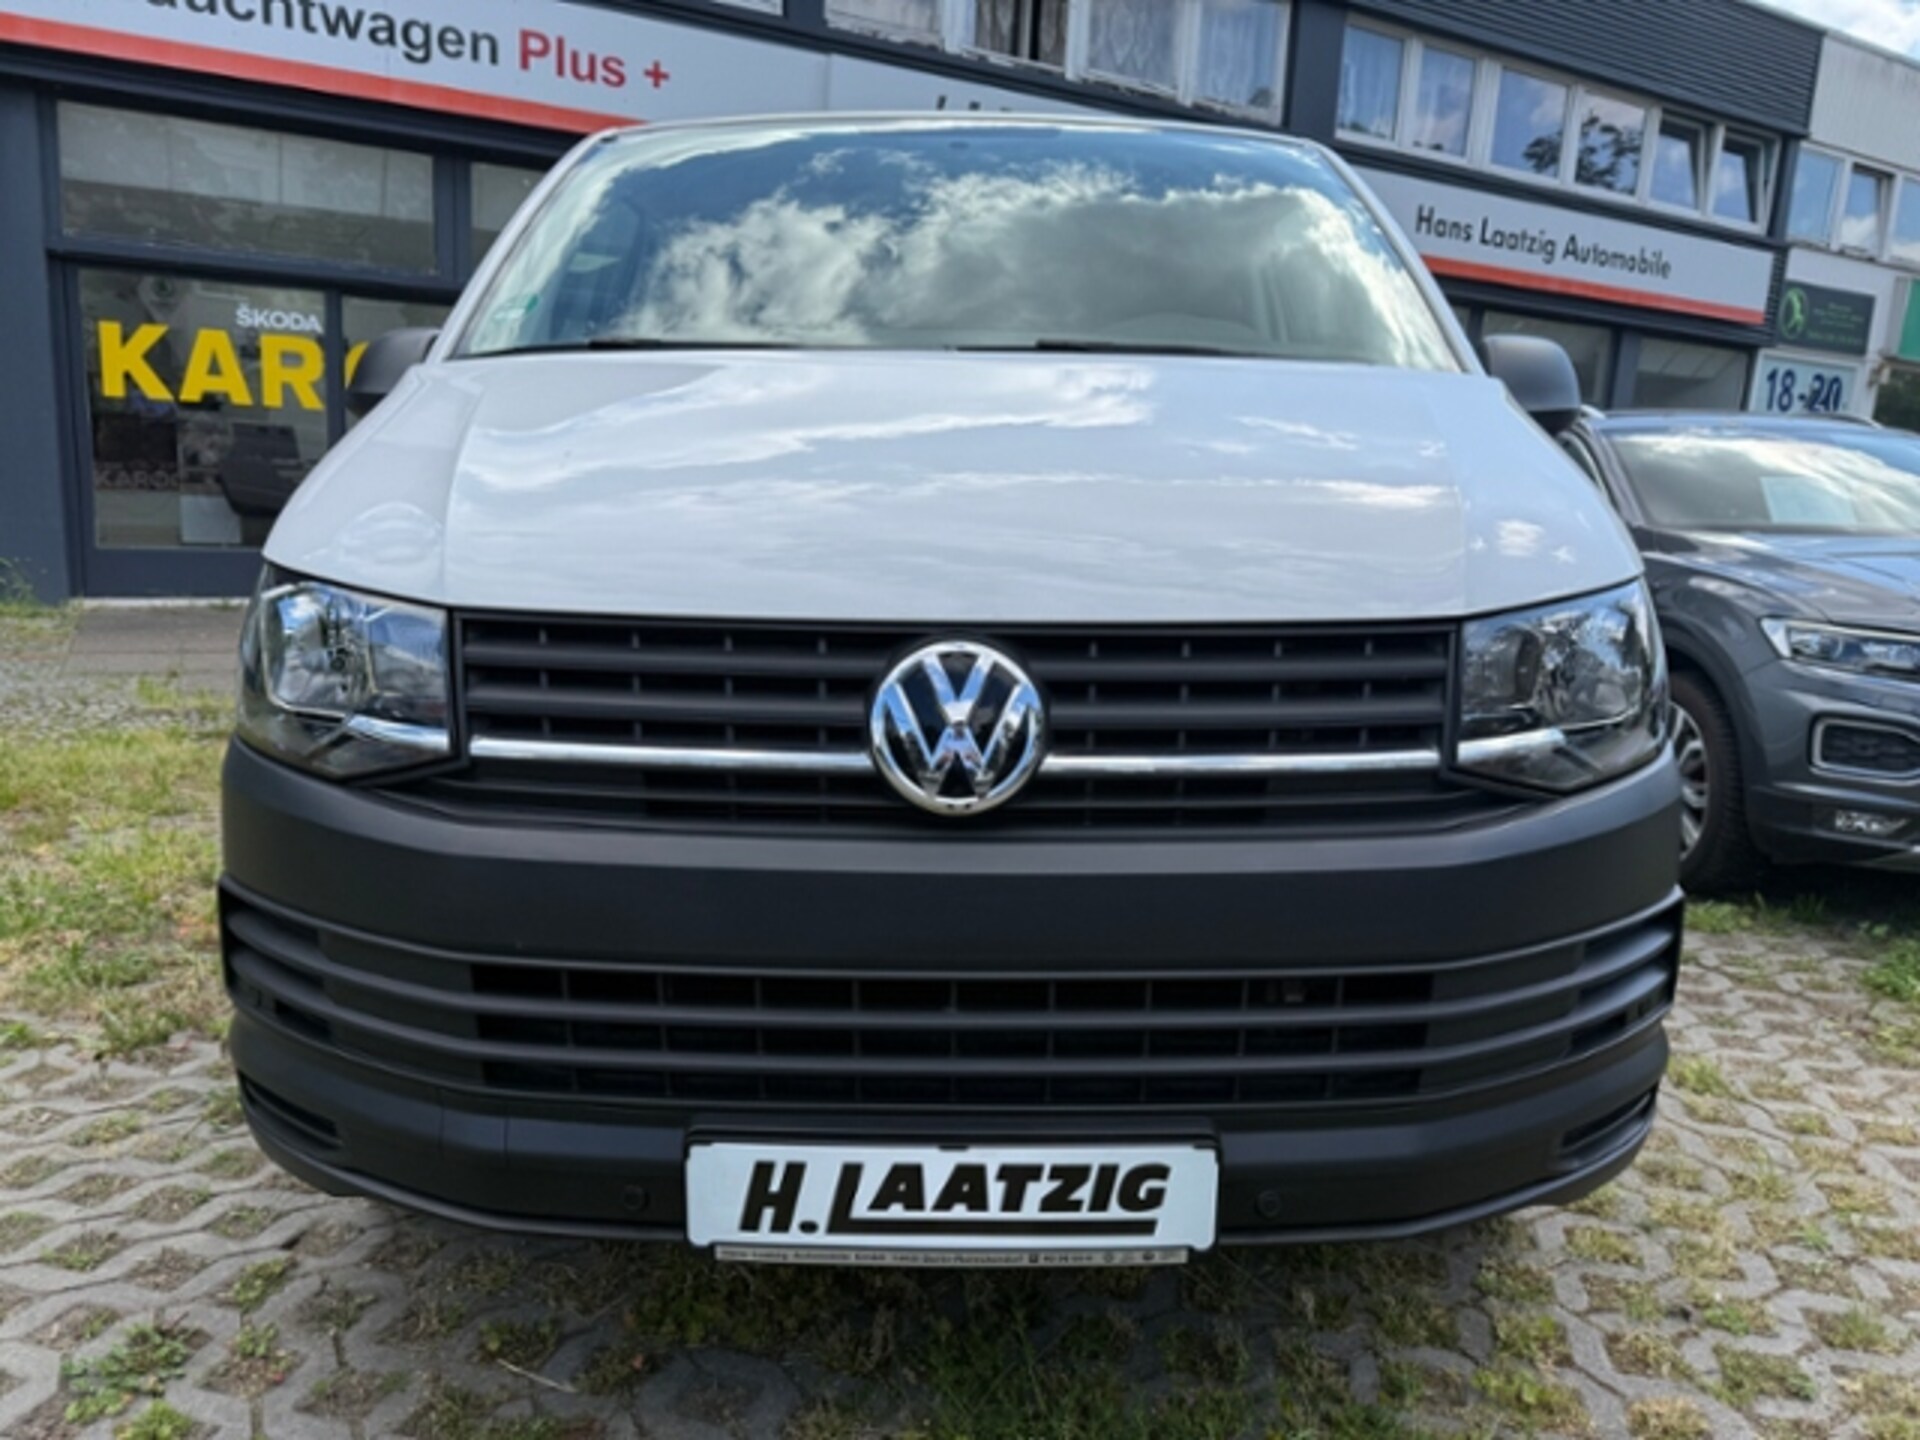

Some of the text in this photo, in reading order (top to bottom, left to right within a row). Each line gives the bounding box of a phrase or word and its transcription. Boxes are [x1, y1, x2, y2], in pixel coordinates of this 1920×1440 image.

[146, 0, 500, 65] uchtwagen
[518, 28, 626, 88] Plus
[1414, 204, 1672, 280] Hans Laatzig Automobile
[235, 303, 323, 333] ŠKODA
[97, 320, 369, 412] KAR
